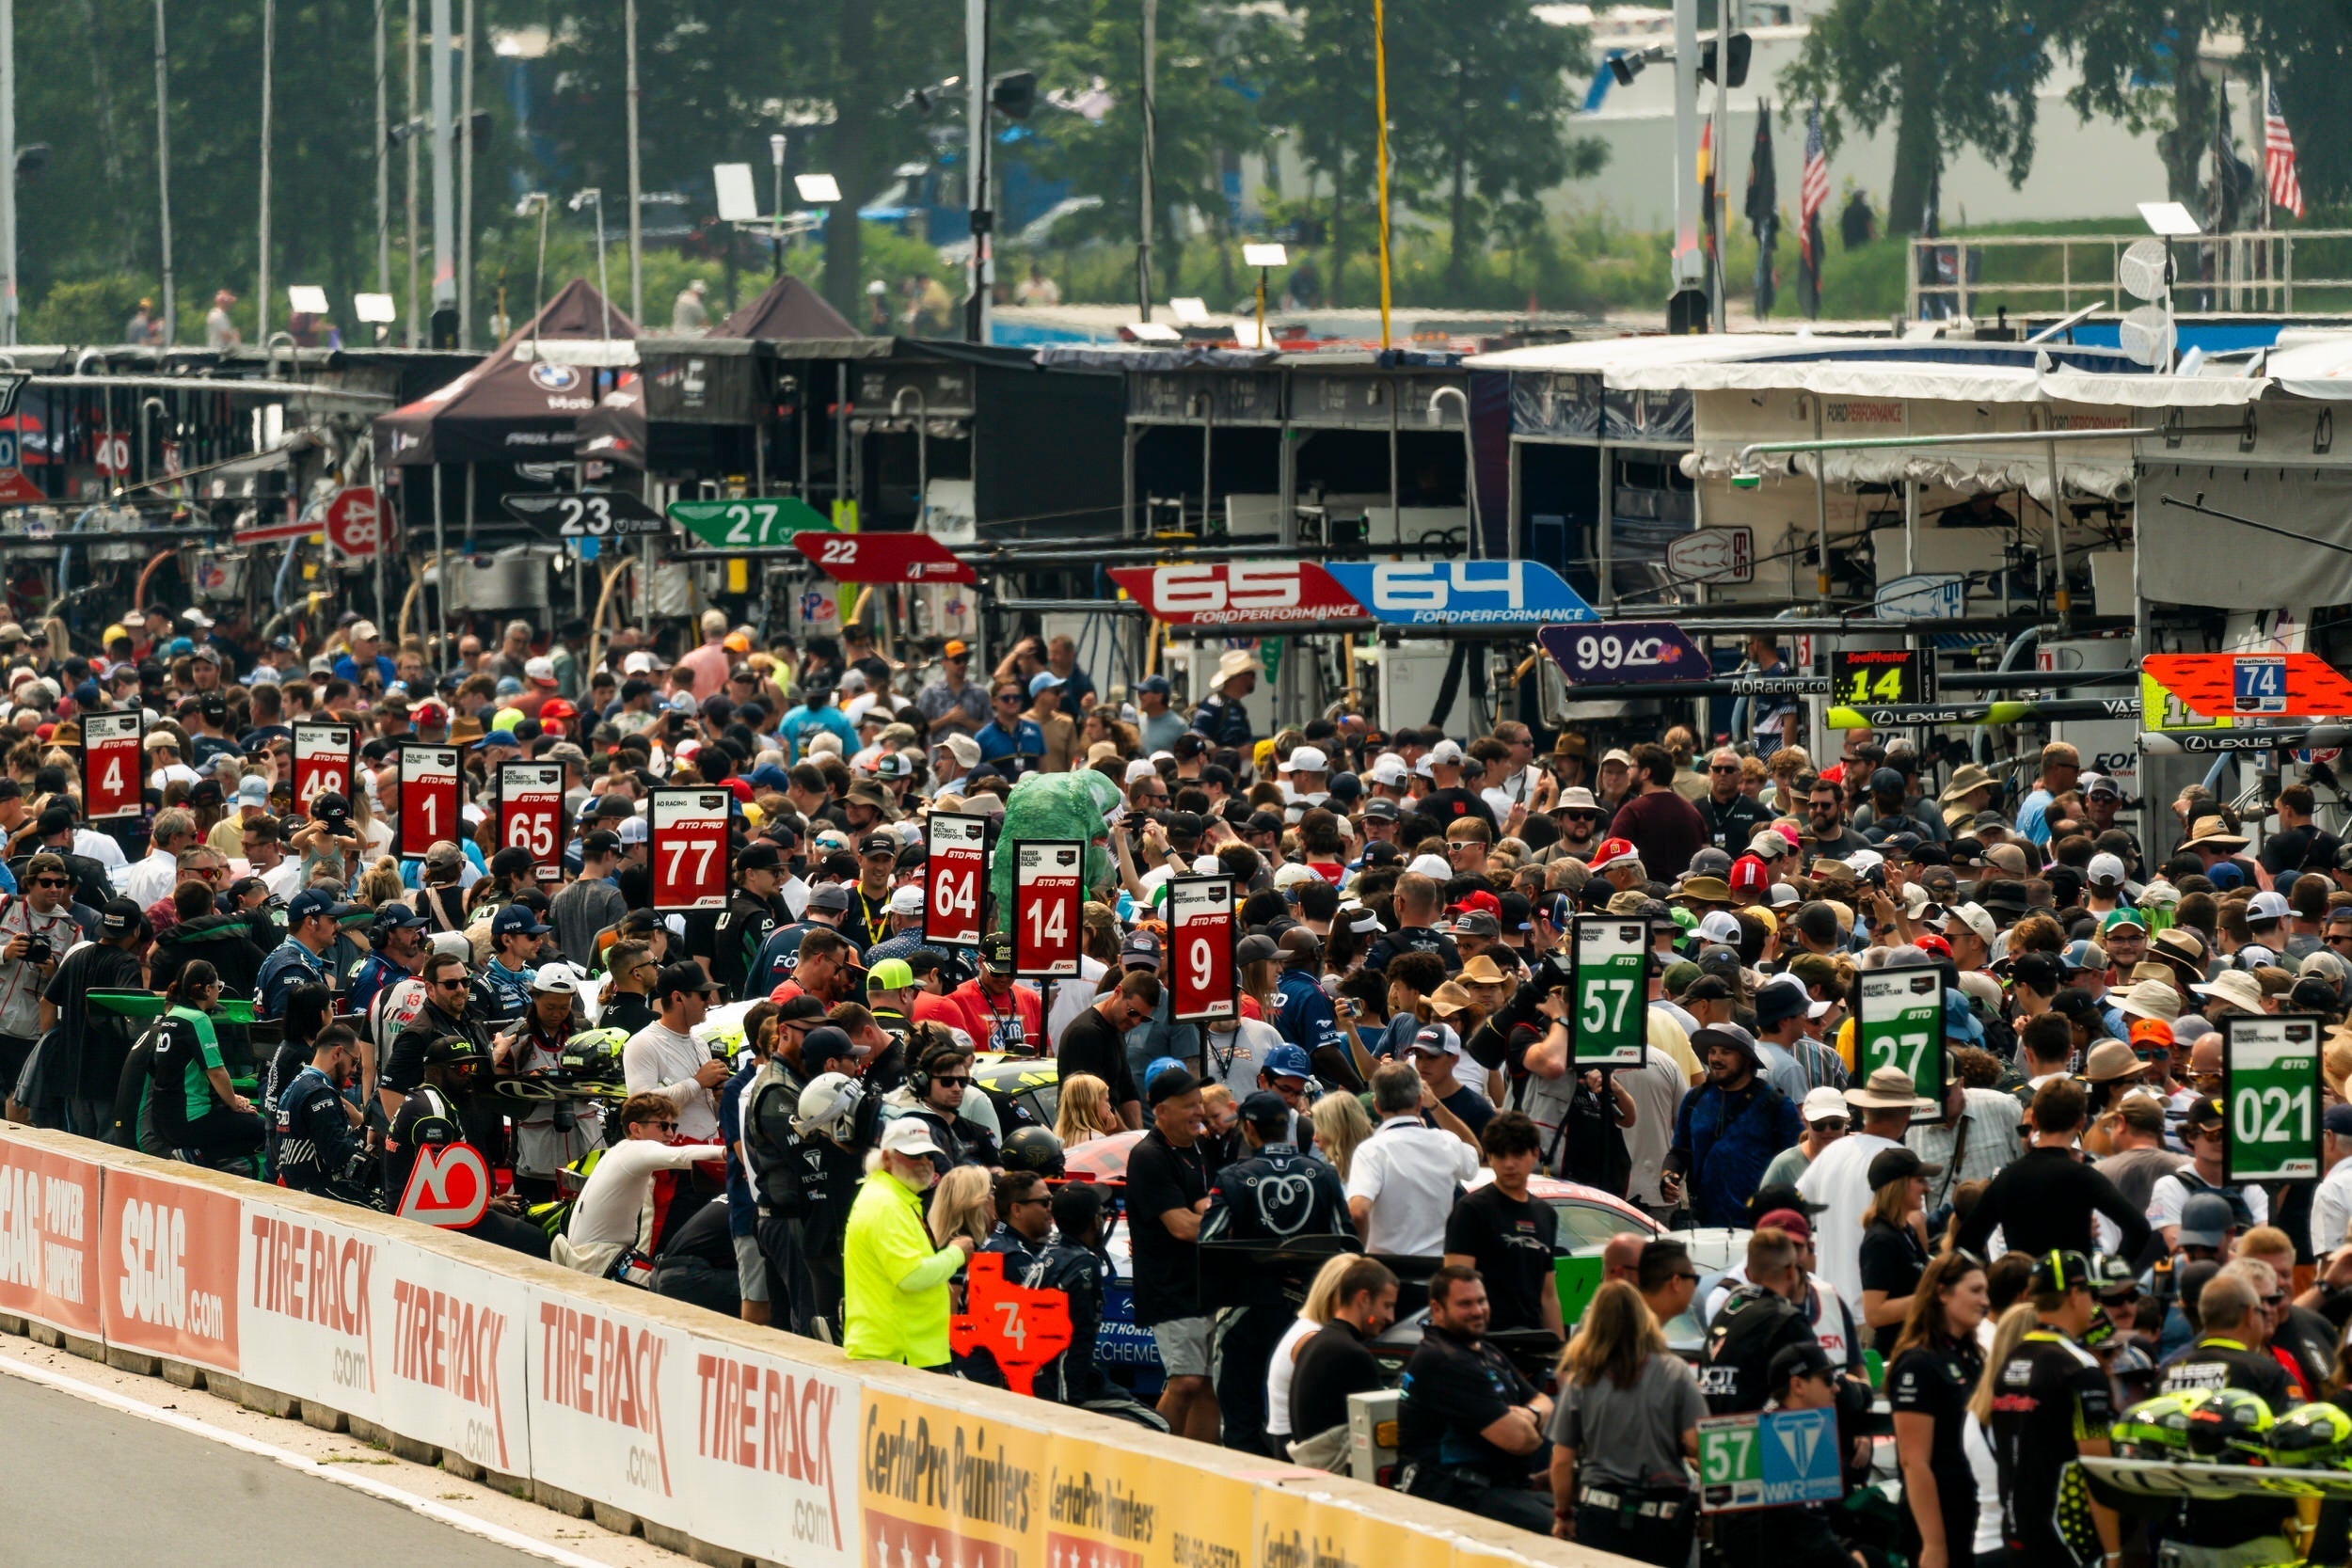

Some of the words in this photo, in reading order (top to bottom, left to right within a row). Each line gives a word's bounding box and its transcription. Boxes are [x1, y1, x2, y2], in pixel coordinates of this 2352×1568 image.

[96, 437, 129, 470] 40
[560, 498, 612, 535] 23
[725, 504, 778, 543] 27
[820, 540, 858, 563] 22
[1152, 561, 1300, 611] 65
[1373, 562, 1524, 610] 64
[1576, 635, 1623, 670] 99
[1846, 651, 1912, 664] SealMaster
[1850, 668, 1902, 703] 14
[2243, 666, 2277, 695] 74
[1895, 711, 1958, 722] LEXUS
[103, 741, 119, 750] GTD
[119, 739, 138, 748] PRO
[2207, 737, 2273, 749] LEXUS
[103, 756, 124, 797] 4
[301, 769, 342, 801] 48
[438, 777, 456, 785] PRO
[422, 794, 437, 836] 1
[676, 821, 699, 830] GTD
[700, 821, 723, 830] PRO
[933, 827, 958, 835] MULTIMATIC
[508, 813, 553, 857] 65
[933, 832, 963, 841] MOTORSPORTS
[661, 840, 717, 886] 77
[947, 850, 963, 860] GTD
[964, 851, 982, 861] PRO
[935, 868, 976, 918] 64
[1037, 879, 1056, 887] GTD
[1027, 898, 1068, 948] 14
[1190, 917, 1209, 927] GTD
[1209, 916, 1227, 925] PRO
[1190, 938, 1212, 990] 9
[1616, 957, 1638, 966] GTD
[405, 993, 421, 1006] 13
[1582, 979, 1634, 1033] 57
[1908, 1008, 1932, 1020] GTD
[1871, 1033, 1929, 1089] 27
[2281, 1059, 2310, 1069] GTD
[2234, 1085, 2312, 1144] 021
[44, 1175, 85, 1243] POWER
[333, 1347, 367, 1391] .com
[465, 1418, 496, 1465] .com
[1706, 1430, 1754, 1481] 57
[626, 1445, 660, 1494] .com
[864, 1403, 949, 1511] CertaPro
[952, 1425, 1031, 1534] Painters
[791, 1497, 830, 1548] .com
[1048, 1465, 1103, 1530] CertaPro
[1105, 1478, 1154, 1544] Painters
